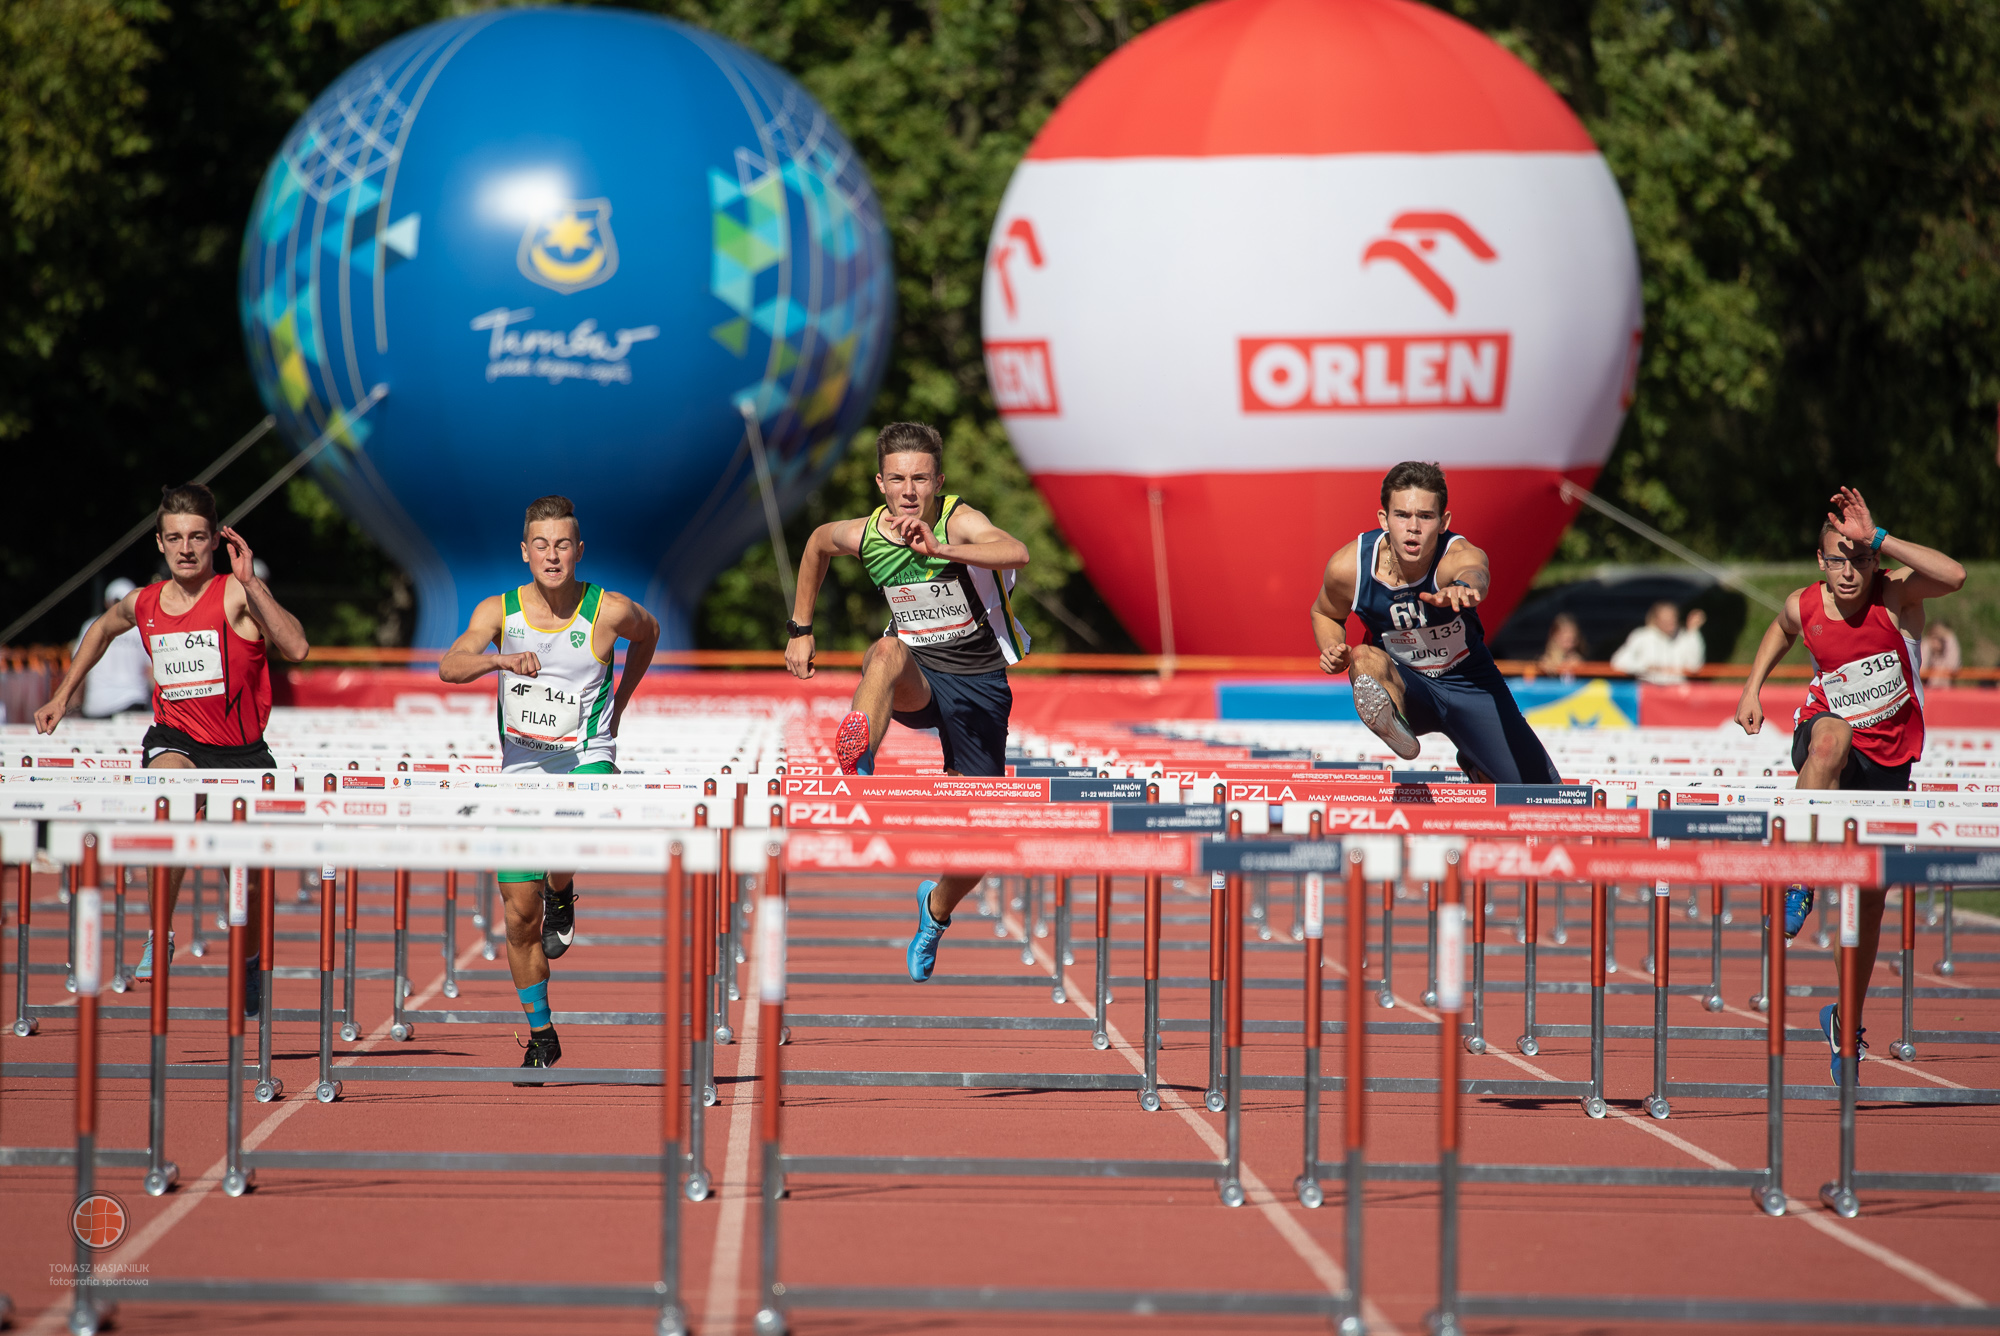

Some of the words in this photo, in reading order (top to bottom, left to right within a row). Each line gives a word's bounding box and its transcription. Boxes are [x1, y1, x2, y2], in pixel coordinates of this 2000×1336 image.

[1247, 339, 1500, 407] ORLEN
[930, 583, 954, 598] 91
[892, 595, 917, 604] ORLEN
[894, 603, 968, 623] SELERZYŃSKI
[912, 633, 945, 645] TARNÓW
[946, 629, 967, 640] 2019
[1428, 620, 1462, 640] 133
[184, 633, 215, 649] 641
[1410, 647, 1449, 660] JUNG
[164, 659, 205, 675] KULUS
[1860, 654, 1895, 677] 318
[194, 686, 213, 696] 2019
[510, 683, 532, 696] 4F
[1829, 675, 1903, 710] WOZIWODZKI
[521, 710, 557, 727] FILAR
[544, 743, 564, 751] 2019
[101, 760, 131, 768] ORLEN
[785, 779, 852, 796] PZLA
[933, 781, 994, 790] MISTRZOSTWA
[995, 782, 1026, 790] POLSKI
[1112, 783, 1141, 791] TARNÓW
[1378, 787, 1440, 796] MISTRZOSTWA
[1440, 788, 1472, 796] POLSKI
[862, 788, 887, 796] MAŁY
[887, 788, 932, 797] MEMORIAŁ
[933, 789, 974, 797] JANUSZA
[974, 789, 1042, 798] KUSOCIŃSKIEGO
[1097, 790, 1126, 798] WRZEŚNIA
[1231, 785, 1297, 801] PZLA
[1307, 794, 1332, 802] MAŁY
[1332, 794, 1378, 803] MEMORIAŁ
[1378, 795, 1418, 803] JANUSZA
[1419, 795, 1487, 804] KUSOCIŃSKIEGO
[1558, 789, 1587, 798] TARNÓW
[1543, 796, 1572, 805] WRZEŚNIA
[789, 802, 872, 825] PZLA
[1328, 807, 1410, 830] PZLA
